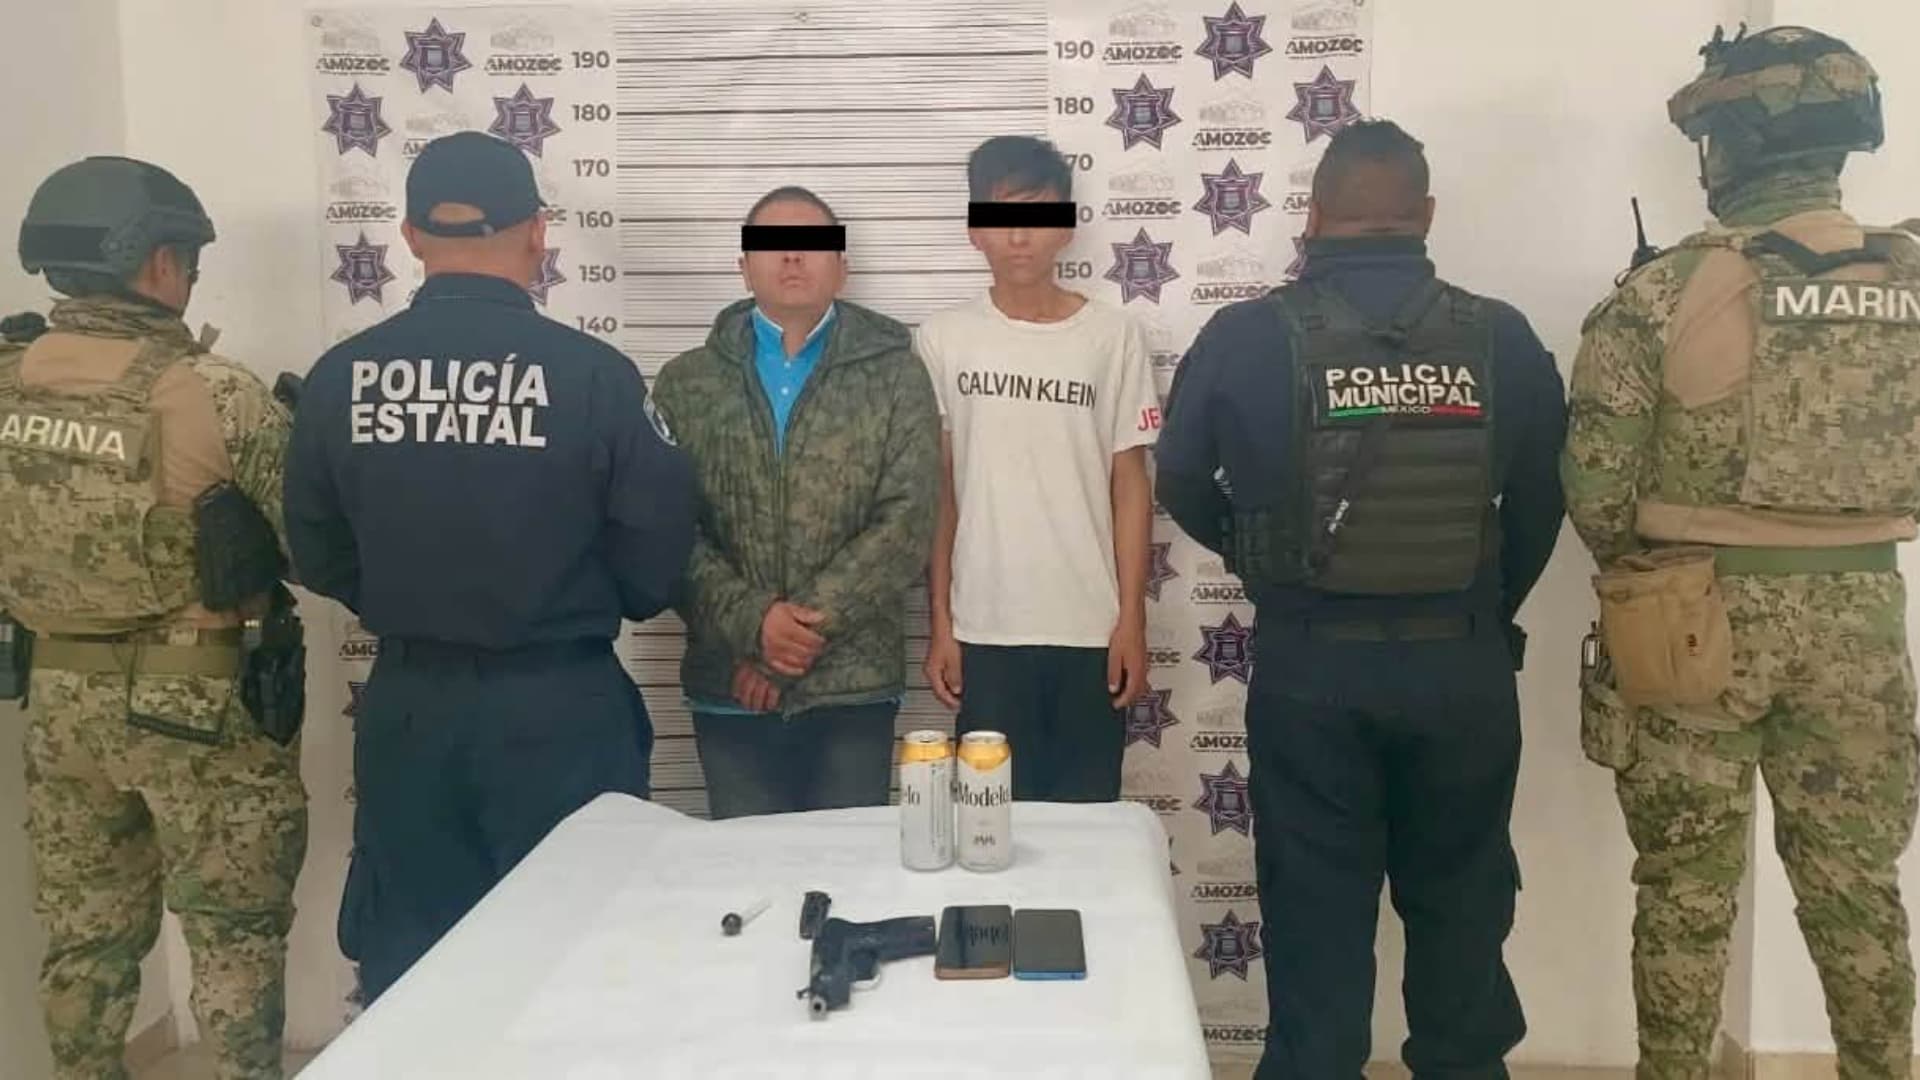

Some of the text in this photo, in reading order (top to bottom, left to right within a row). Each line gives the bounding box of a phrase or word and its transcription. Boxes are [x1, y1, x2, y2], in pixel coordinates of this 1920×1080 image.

[572, 51, 610, 68] 190
[1054, 42, 1094, 60] 190
[1102, 46, 1182, 61] AMOZOC
[573, 104, 610, 121] 180
[1054, 97, 1094, 115] 180
[1192, 131, 1272, 147] AMOZOC
[573, 159, 610, 177] 170
[1064, 154, 1093, 171] 70
[1102, 201, 1181, 216] AMOZOC
[576, 211, 613, 228] 160
[579, 265, 616, 282] 150
[1056, 262, 1092, 280] 150
[1776, 285, 1920, 319] MARIN
[576, 316, 617, 333] 140
[352, 353, 550, 406] POLICÍA
[1325, 364, 1476, 386] POLICIA
[957, 371, 1097, 409] CALVIN KLEIN
[1328, 384, 1481, 409] MUNICIPAL
[352, 402, 547, 447] ESTATAL
[1137, 407, 1162, 432] JE
[0, 413, 126, 461] ARINA
[1191, 587, 1245, 600] AMOZ
[1147, 651, 1181, 663] ZOC
[1190, 736, 1248, 748] AMOZ
[1190, 885, 1257, 898] AMOZO
[1204, 1027, 1269, 1041] MOZOC
